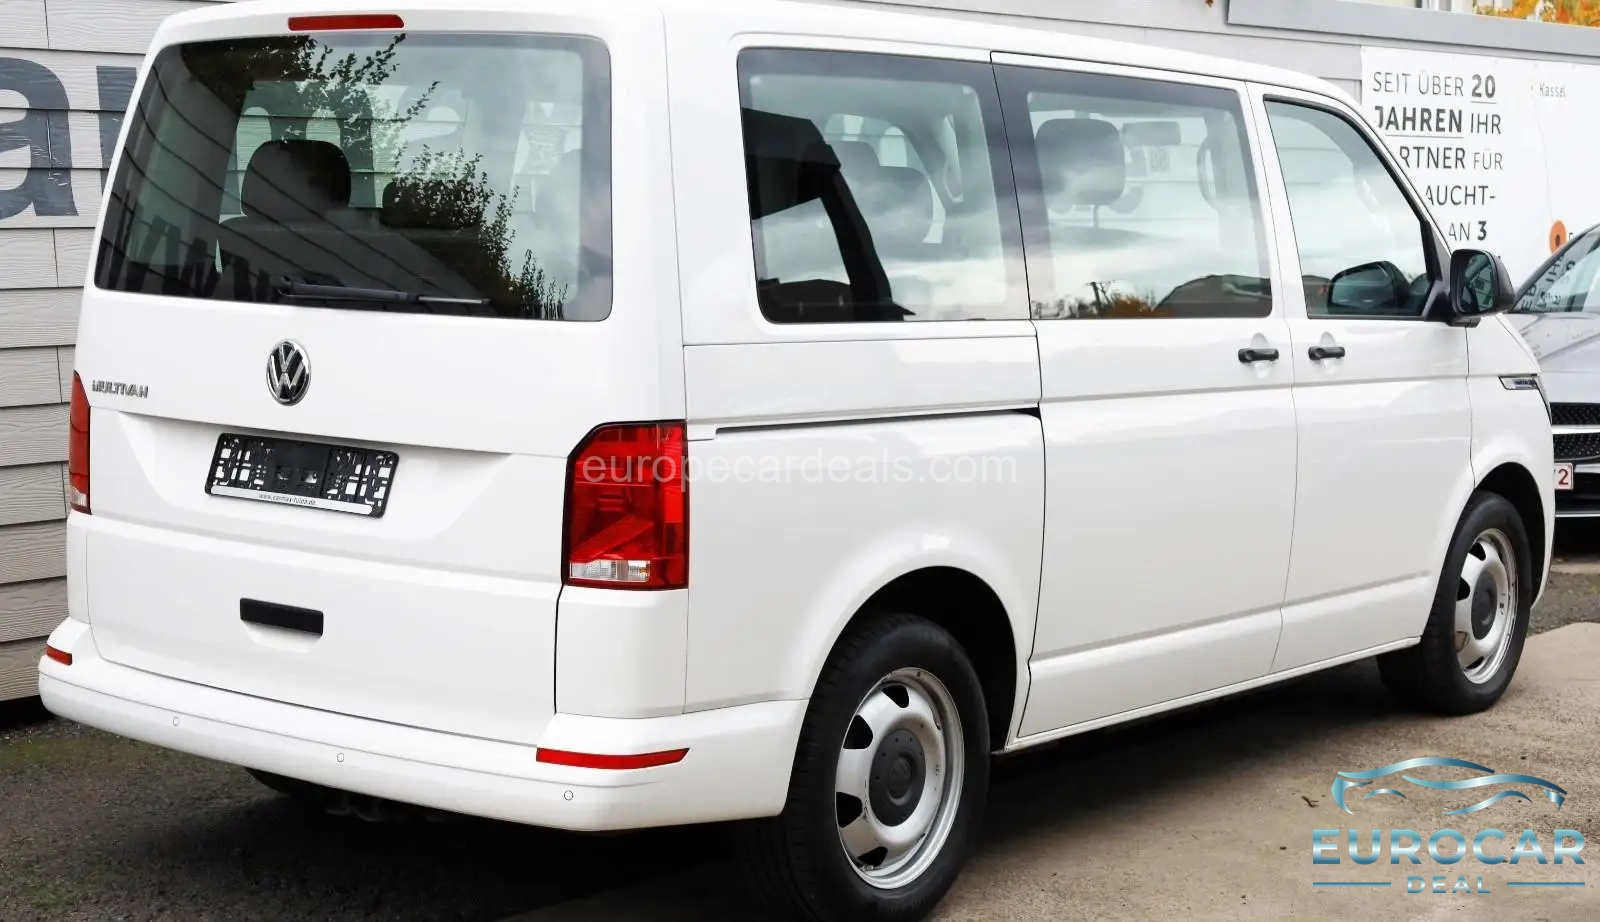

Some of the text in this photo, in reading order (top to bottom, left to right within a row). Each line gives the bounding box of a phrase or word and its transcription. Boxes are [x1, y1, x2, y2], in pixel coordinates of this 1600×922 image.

[1372, 69, 1496, 99] SEIT ÜBER 20
[1374, 105, 1502, 135] JAHREN IHR
[1399, 145, 1504, 171] RTNER FÜR
[1425, 185, 1496, 206] AUCHT-
[1476, 220, 1488, 242] 3
[91, 379, 149, 399] MULTIVAN
[1555, 468, 1569, 486] 2
